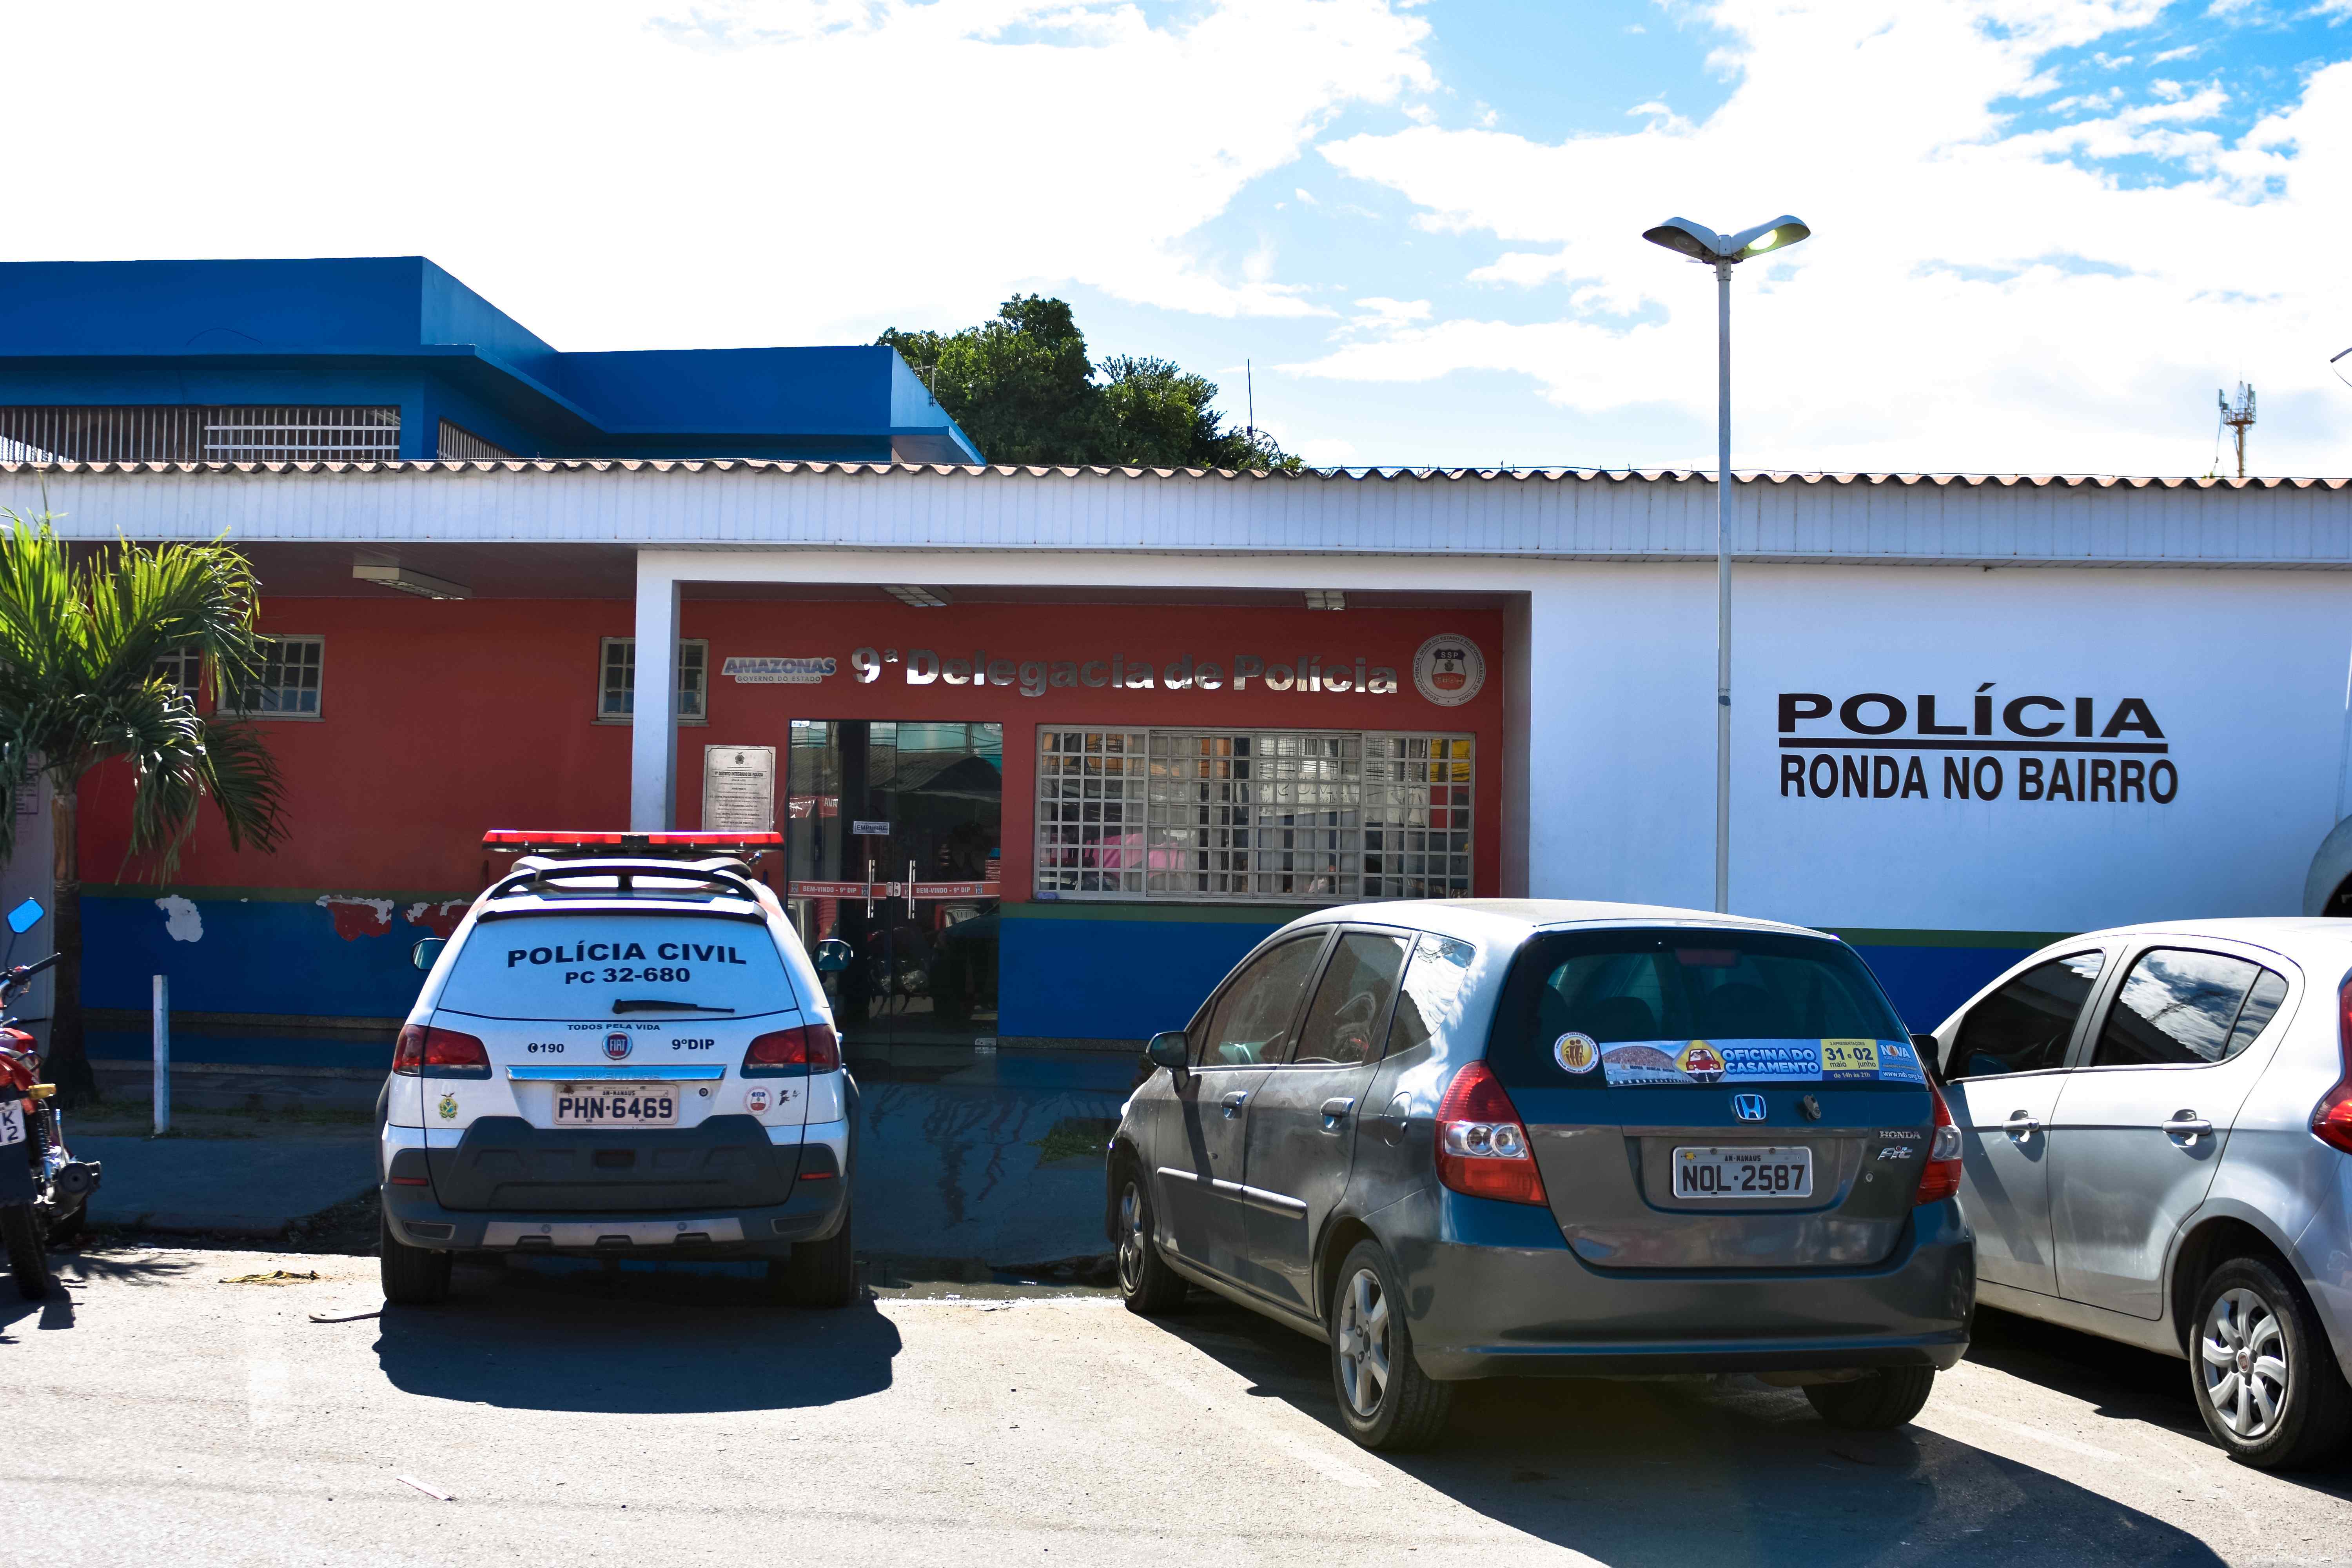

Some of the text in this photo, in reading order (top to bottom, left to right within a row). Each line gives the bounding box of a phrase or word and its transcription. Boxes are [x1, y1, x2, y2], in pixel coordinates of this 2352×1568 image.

[725, 659, 836, 674] AMAZONAS
[906, 649, 1155, 697] Delegacia
[1163, 654, 1224, 690] de
[1233, 654, 1398, 694] Polícia
[1419, 642, 1432, 655] DEVER
[1458, 690, 1474, 702] TODOS
[1778, 681, 2166, 739] POLÍCIA
[1780, 753, 2179, 805] RONDA NO BAIRRO
[507, 940, 747, 968] POLÍCIA CIVIL
[565, 967, 691, 985] PC 32-680
[539, 1043, 564, 1053] 190
[609, 1039, 626, 1051] FIAT
[1722, 1049, 1815, 1061] OFICINA DO
[1825, 1047, 1846, 1061] 31
[1853, 1047, 1874, 1060] 02
[1725, 1062, 1819, 1073] CASAMENTO
